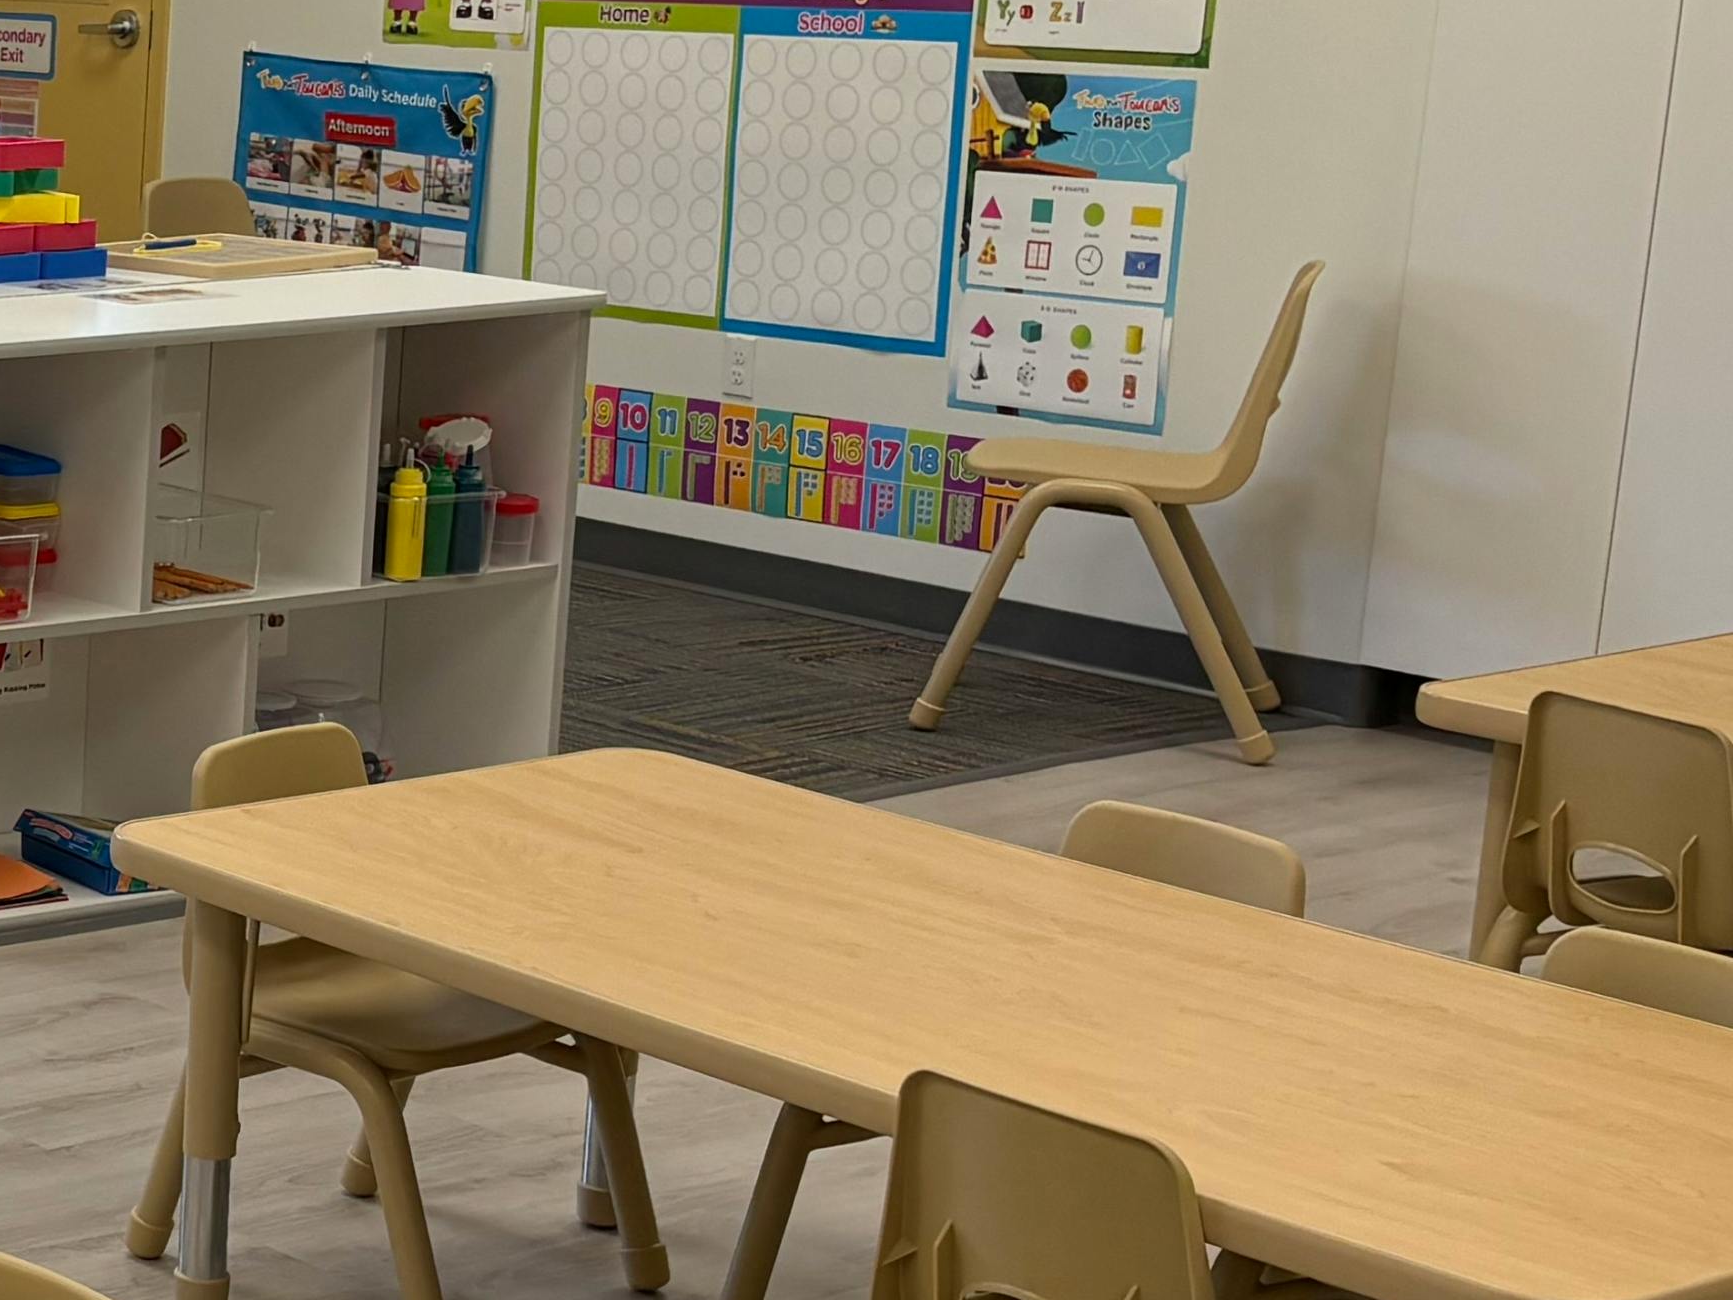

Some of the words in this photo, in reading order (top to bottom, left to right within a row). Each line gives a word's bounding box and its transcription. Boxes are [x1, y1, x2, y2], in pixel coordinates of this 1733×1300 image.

[598, 5, 650, 24] Home
[798, 12, 864, 35] School
[0, 47, 24, 63] Exit
[349, 84, 379, 101] Daily
[382, 90, 437, 108] Schedule
[1117, 92, 1181, 114] Toucan's
[328, 118, 390, 137] Afternoon
[1093, 111, 1151, 131] Shapes
[595, 398, 614, 427] 9
[619, 402, 649, 433] 10
[657, 407, 678, 436] 11
[688, 412, 716, 443] 12
[723, 417, 750, 447] 13
[757, 421, 787, 453] 14
[796, 428, 825, 458] 15
[833, 431, 864, 466] 16
[871, 438, 902, 469] 17
[909, 444, 939, 476] 18
